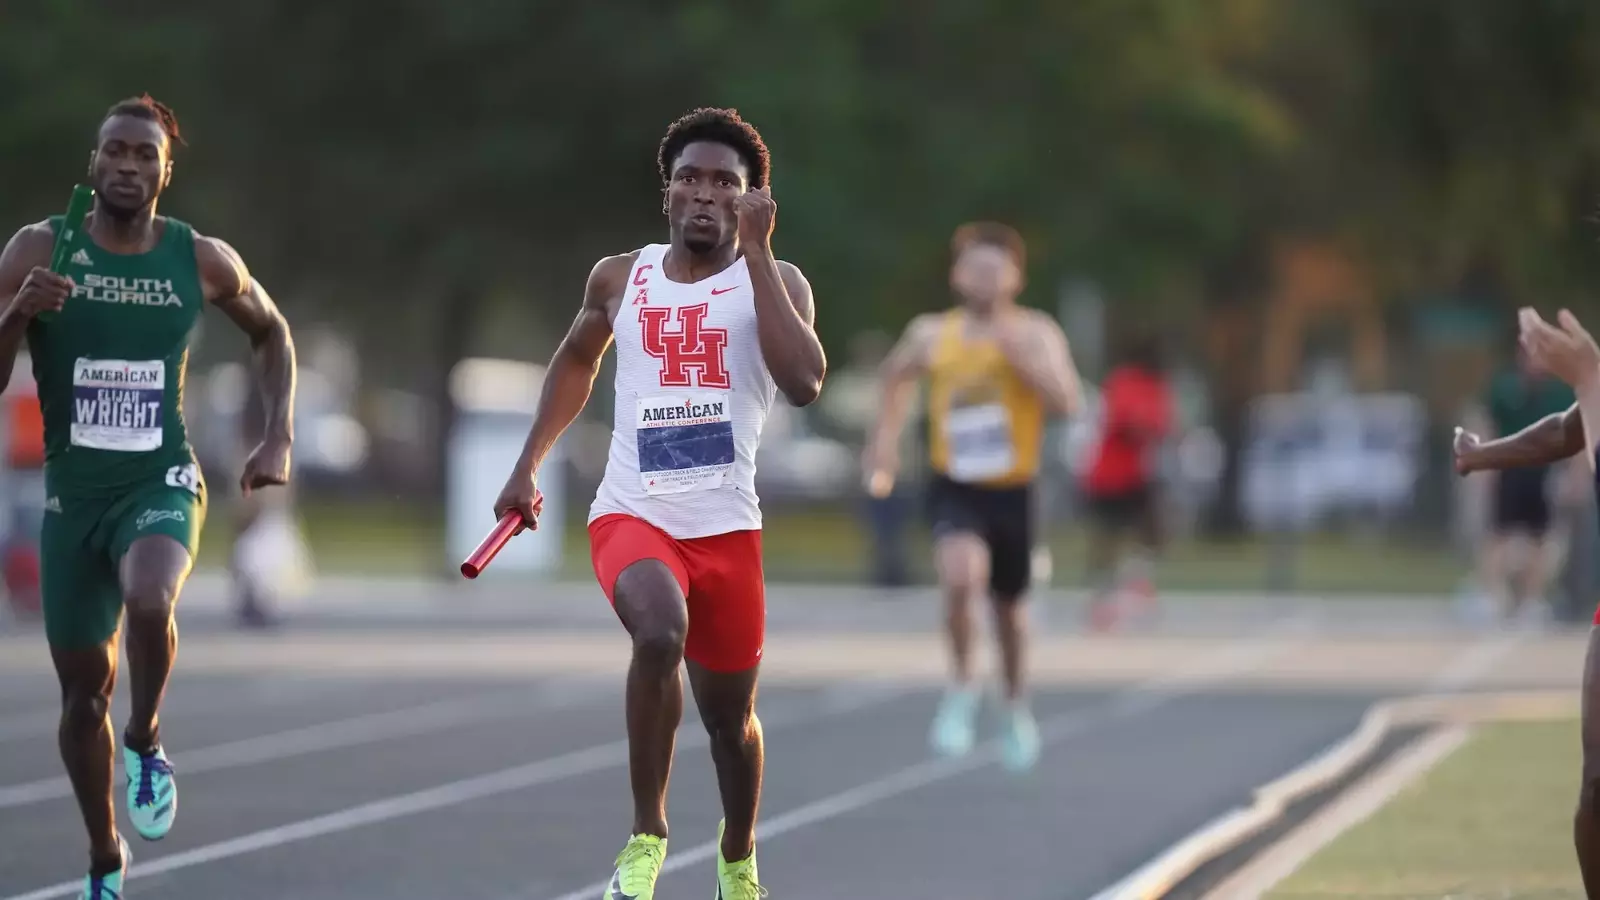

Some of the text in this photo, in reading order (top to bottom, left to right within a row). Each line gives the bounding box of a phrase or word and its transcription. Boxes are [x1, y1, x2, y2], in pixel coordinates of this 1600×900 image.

[84, 273, 173, 292] SOUTH
[633, 264, 653, 286] C
[71, 285, 183, 307] FLORIDA
[638, 302, 731, 389] UH
[80, 366, 159, 383] AMERICAN
[98, 389, 139, 404] ELIJAH
[76, 398, 160, 428] WRIGHT
[642, 401, 724, 421] AMERICAN
[646, 417, 721, 428] ATHLETIC CONFERENCE
